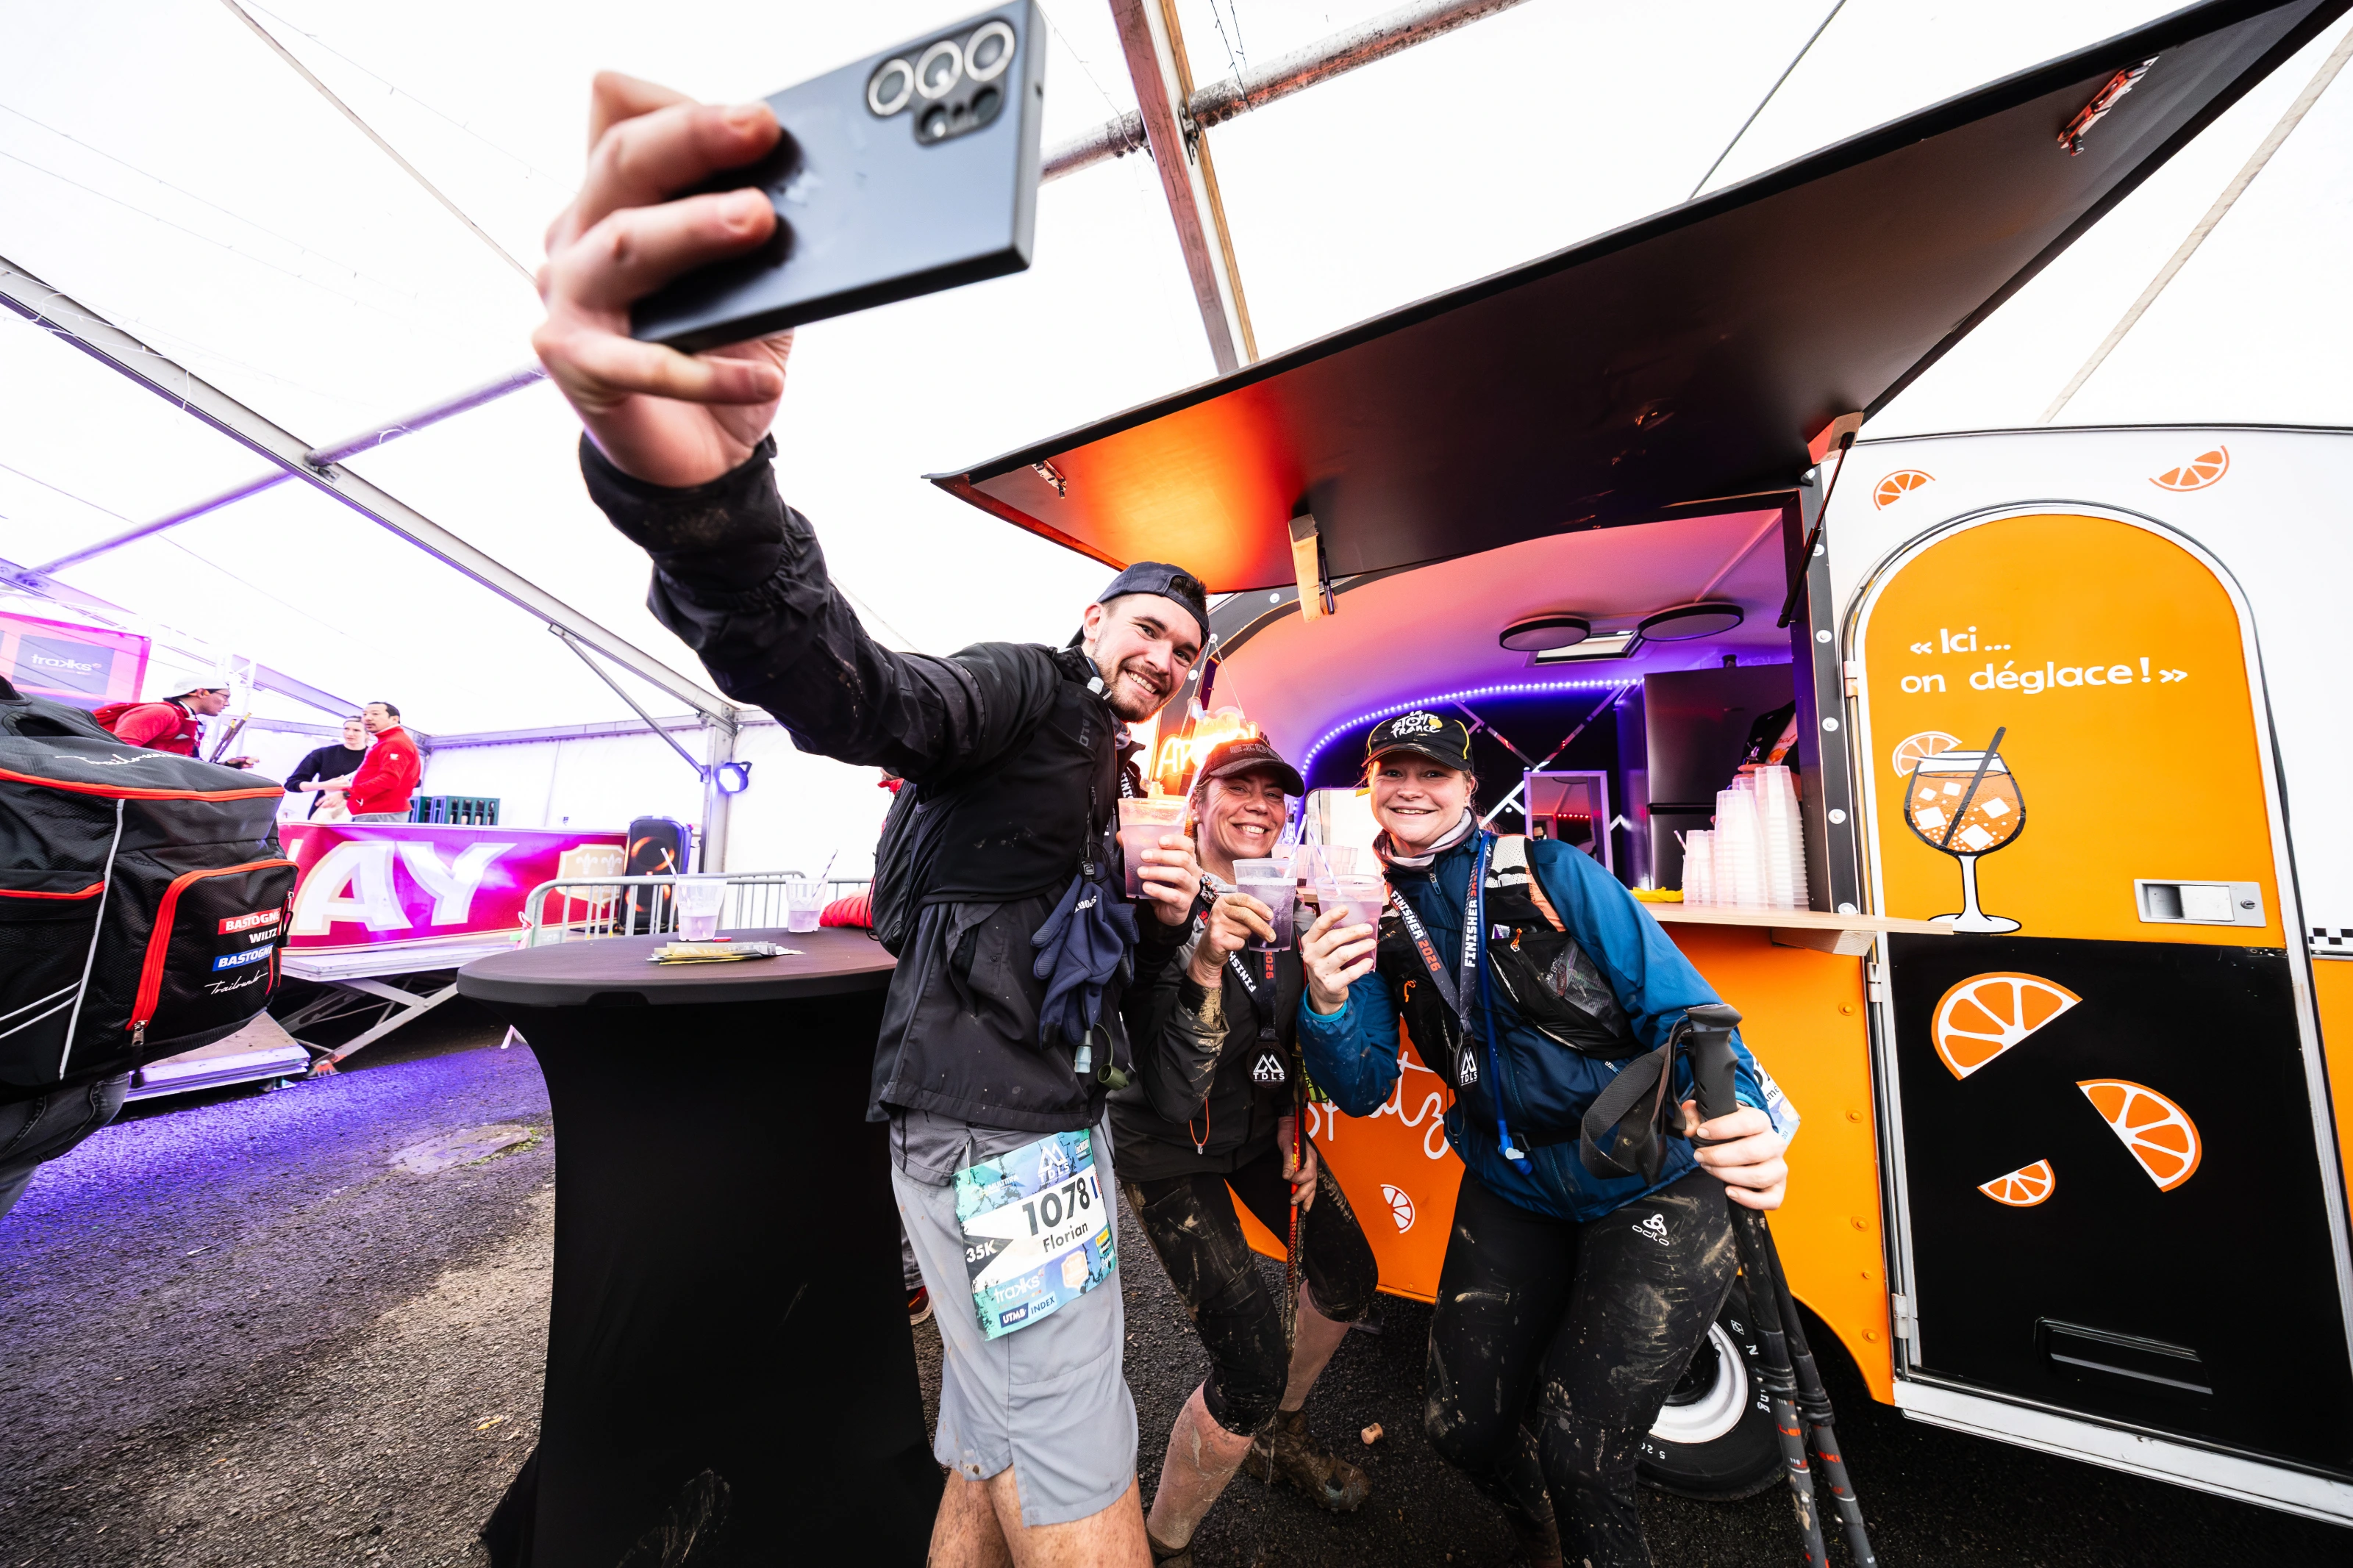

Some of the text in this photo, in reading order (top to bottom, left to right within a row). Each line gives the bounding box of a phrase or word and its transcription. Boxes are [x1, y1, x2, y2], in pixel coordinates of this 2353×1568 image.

[31, 654, 93, 671] trakks
[1900, 673, 1946, 694] on
[285, 839, 518, 936] AY
[249, 928, 278, 943] WILTZ
[1390, 890, 1442, 973] FINISHER 2026
[1464, 899, 1478, 968] FINISHER
[1460, 1071, 1477, 1084] TDLS
[1038, 1162, 1071, 1184] TDLS
[1021, 1177, 1090, 1236] 1078
[1043, 1222, 1089, 1253] Florian
[1632, 1225, 1670, 1246] odlo
[965, 1239, 998, 1264] 35K
[993, 1275, 1040, 1304] trakks
[1002, 1308, 1026, 1324] UTMB
[1031, 1295, 1056, 1314] INDEX
